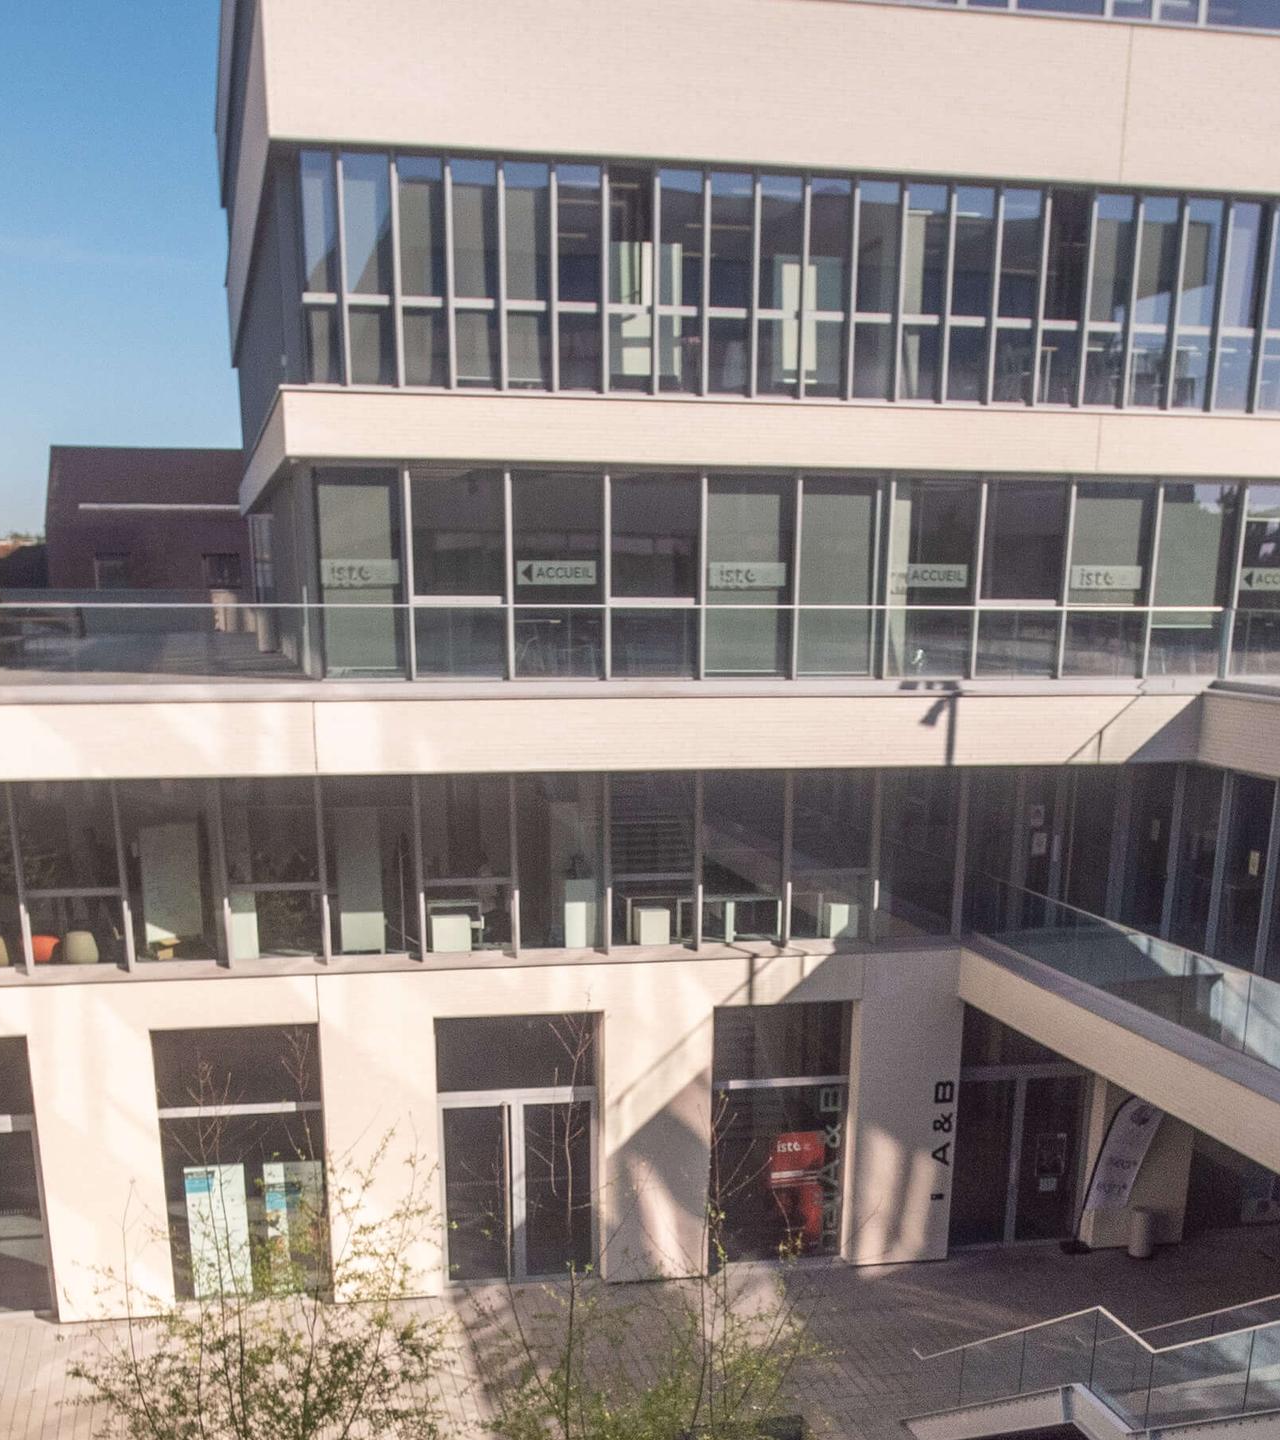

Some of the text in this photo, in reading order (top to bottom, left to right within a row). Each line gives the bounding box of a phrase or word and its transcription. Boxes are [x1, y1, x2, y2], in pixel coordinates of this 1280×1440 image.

[536, 566, 593, 579] ACCUEIL
[912, 569, 965, 582] ACCUEIL
[931, 1081, 955, 1166] A & B
